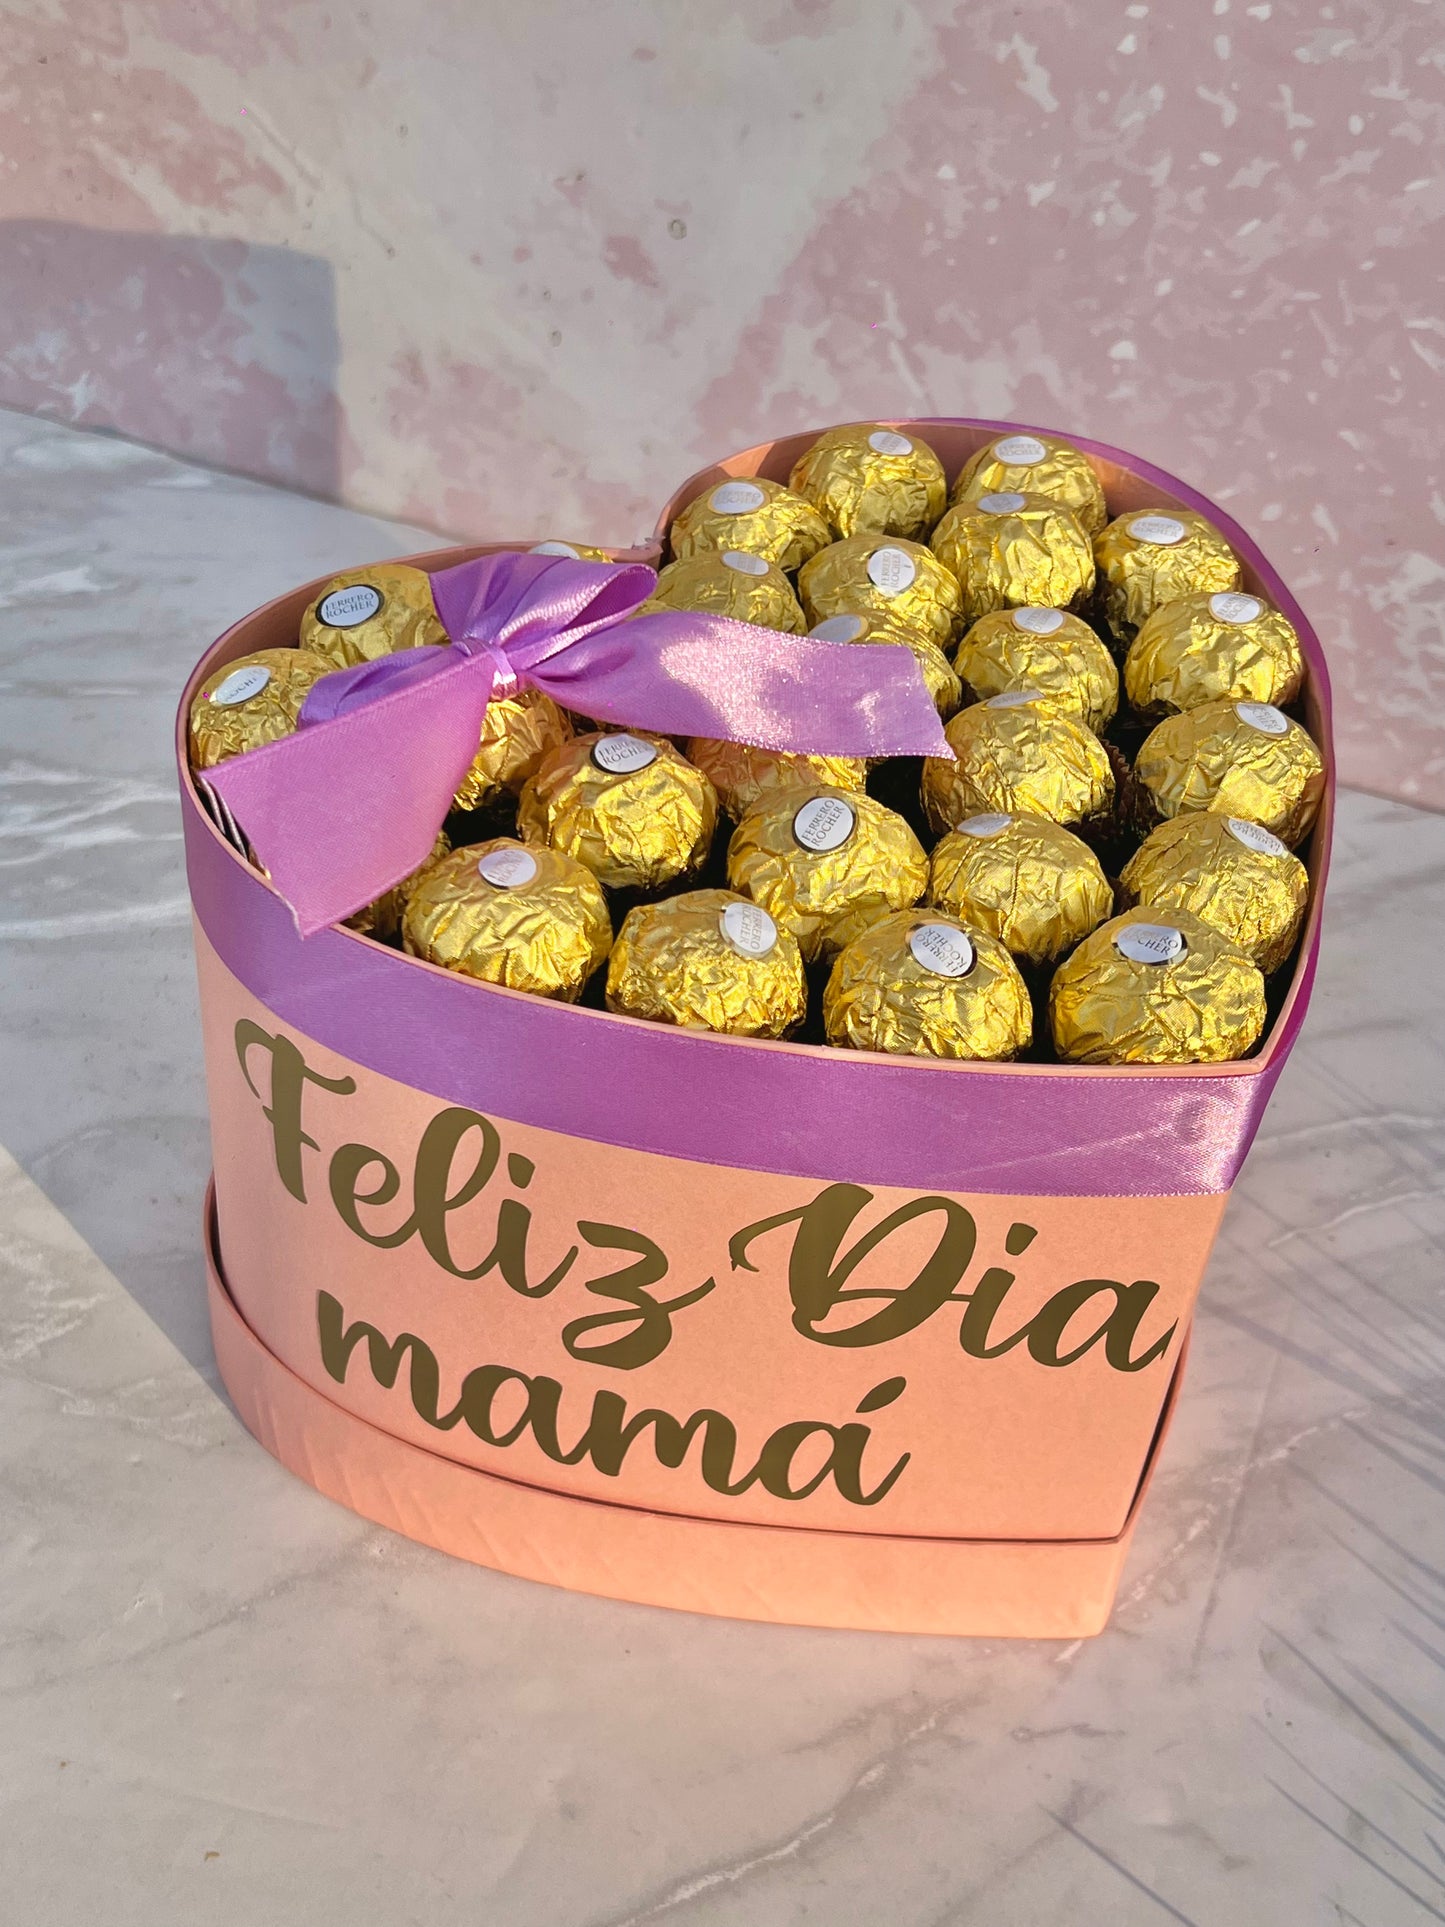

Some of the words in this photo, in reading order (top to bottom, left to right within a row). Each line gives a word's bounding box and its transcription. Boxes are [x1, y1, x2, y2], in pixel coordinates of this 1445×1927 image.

[881, 551, 891, 586] FERRERO
[890, 553, 901, 588] ROCHER
[325, 592, 374, 611] FERRERO
[326, 600, 375, 619] ROCHER
[801, 800, 835, 841] FERRERO
[811, 806, 845, 847] ROCHER
[739, 906, 752, 945] ROCHER
[751, 907, 763, 950] FERRERO
[916, 934, 960, 973] FERRERO
[924, 928, 967, 968] ROCHER
[235, 1019, 715, 1370] Feliz
[729, 1183, 1179, 1372] Dia
[317, 1289, 911, 1505] mamá
